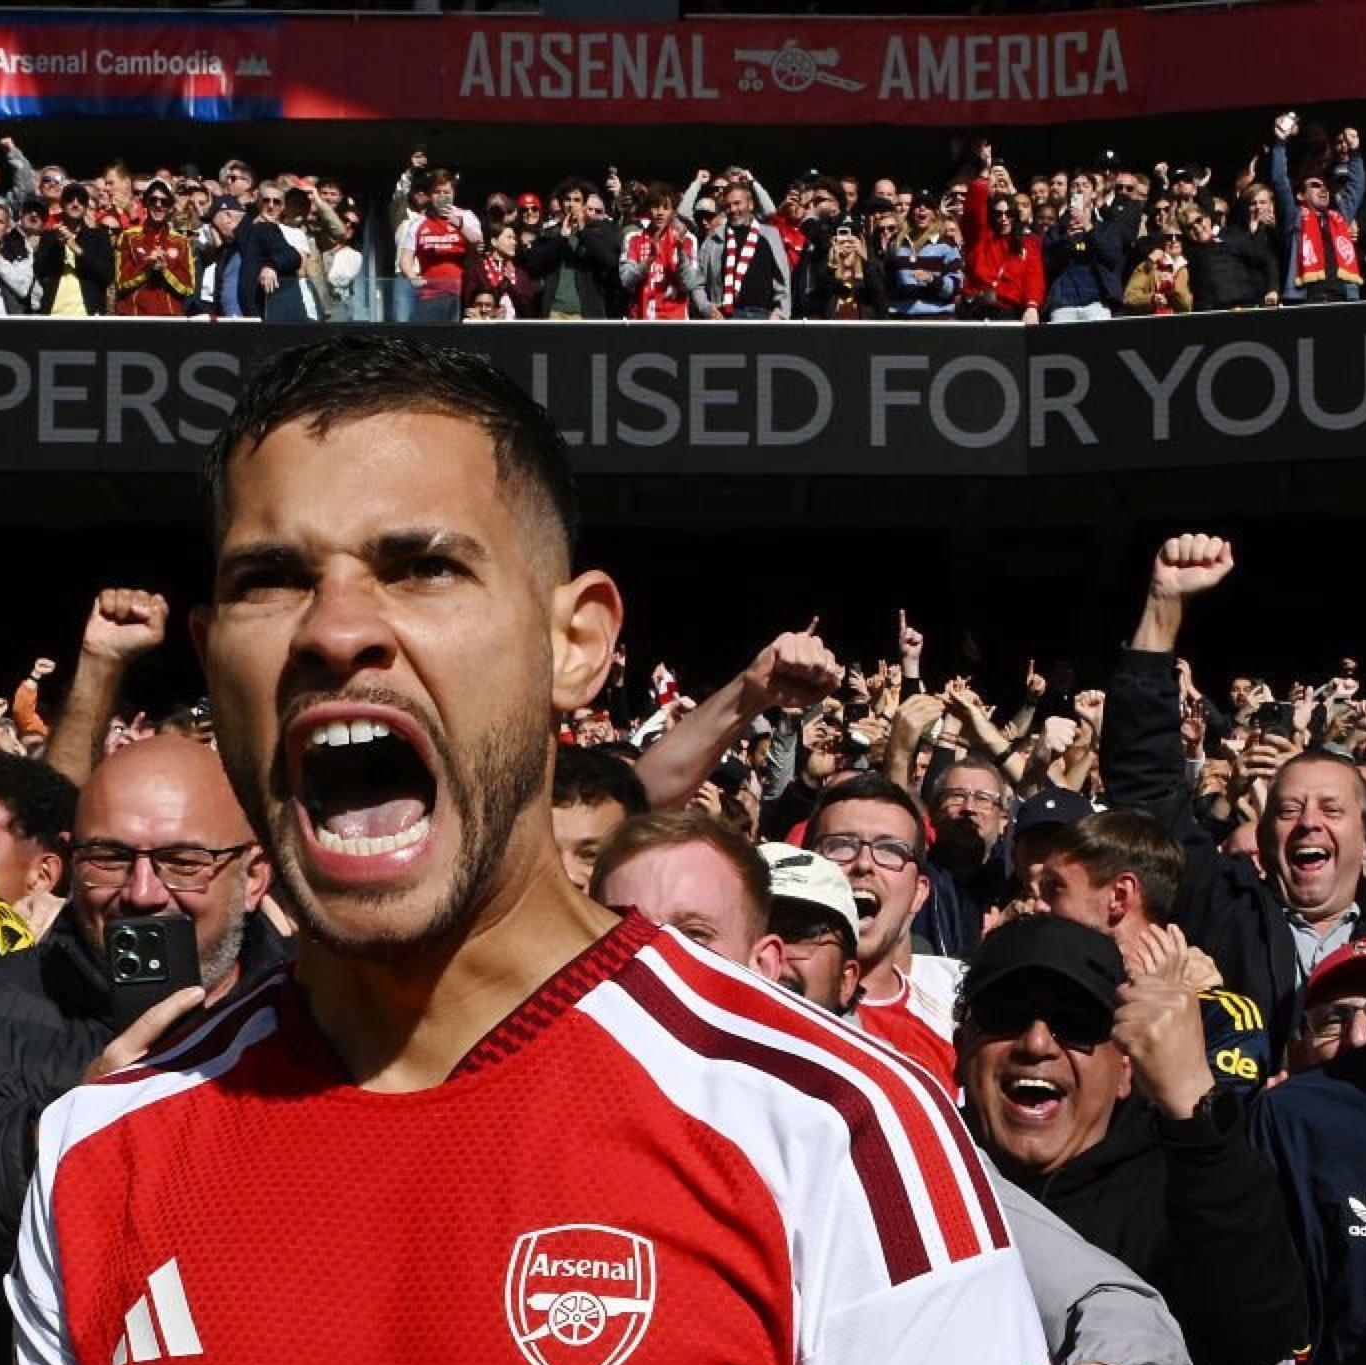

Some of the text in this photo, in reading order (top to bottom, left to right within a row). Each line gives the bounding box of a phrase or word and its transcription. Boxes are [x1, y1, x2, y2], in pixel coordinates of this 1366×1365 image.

[96, 49, 223, 75] Cambodia
[460, 28, 1128, 101] ARSENAL AMERICA
[871, 355, 1099, 448] FOR
[529, 1253, 635, 1281] Arsenal
